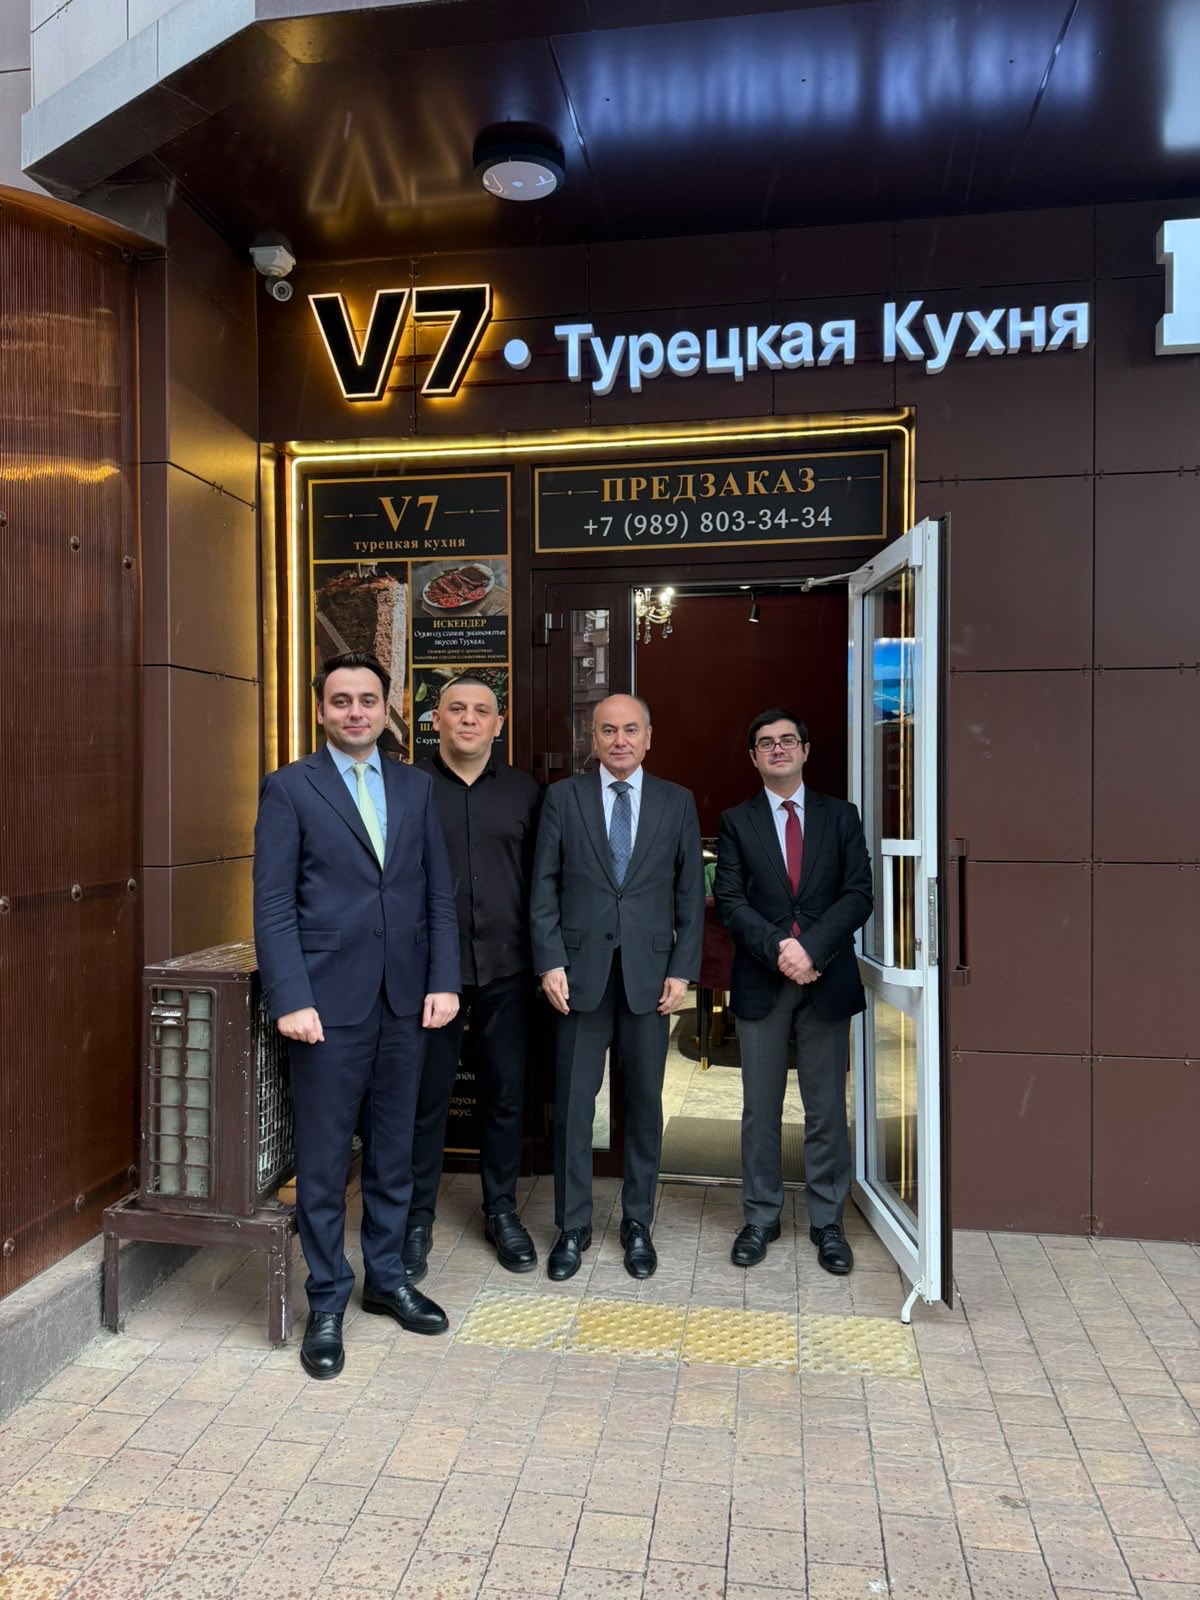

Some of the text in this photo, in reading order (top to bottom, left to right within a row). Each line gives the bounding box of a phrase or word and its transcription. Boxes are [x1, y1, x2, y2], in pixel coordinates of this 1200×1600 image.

[307, 284, 1090, 402] V7 Турецкая Кухня
[601, 467, 816, 503] ПРЕДЗАКАЗ
[378, 495, 440, 532] V7
[584, 506, 833, 541] +7 (989) 803-34-34
[354, 537, 466, 552] турецкая кухня
[433, 619, 487, 629] ИСКЕНДЕР
